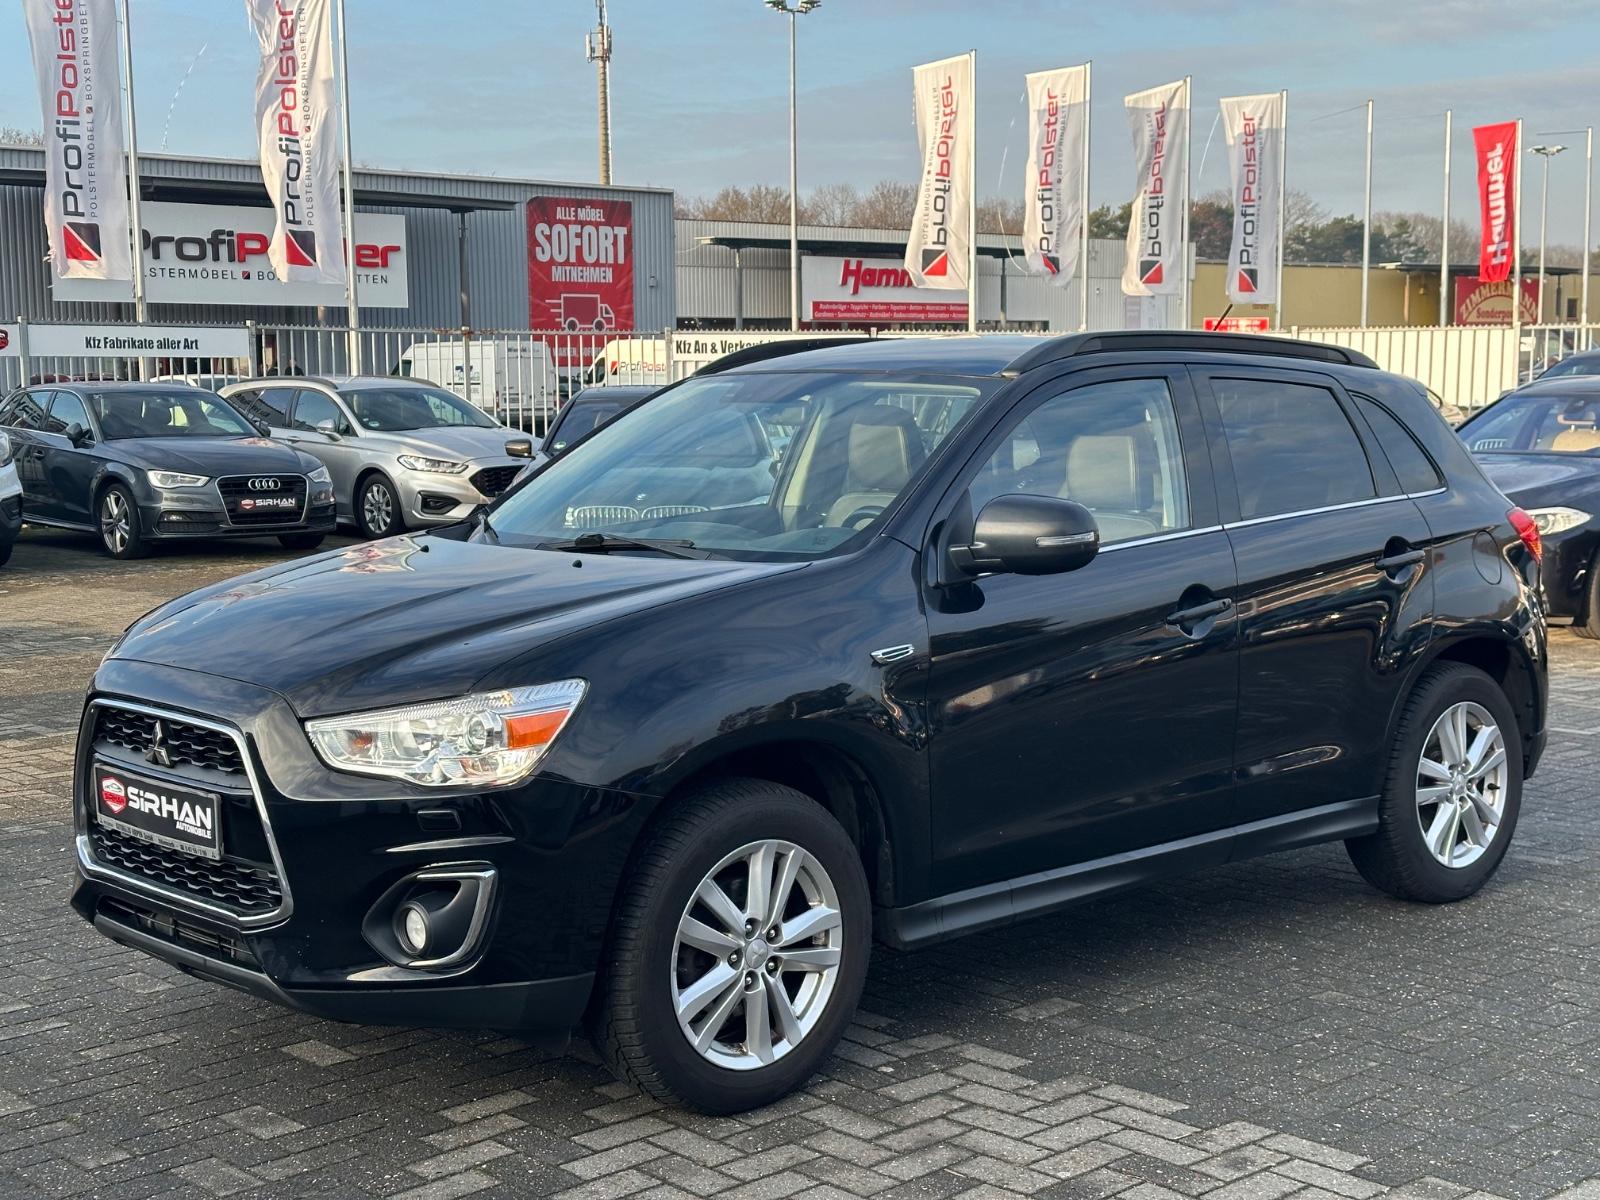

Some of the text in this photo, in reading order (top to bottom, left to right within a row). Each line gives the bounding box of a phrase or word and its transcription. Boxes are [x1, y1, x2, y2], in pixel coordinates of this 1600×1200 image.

[274, 0, 302, 225] ProfiPolster
[1037, 87, 1058, 253] ProfiPolster
[1239, 111, 1256, 265] ProfiPolster
[556, 205, 605, 222] ALLE MÖBEL
[1486, 142, 1509, 265] Hammer
[534, 222, 628, 265] SOFORT
[551, 265, 613, 284] MITNEHMEN
[1459, 281, 1537, 321] ZIMMERMNN
[85, 336, 199, 350] Kfz Fabrikate aller Art
[676, 340, 692, 354] Kfz
[694, 340, 708, 354] An
[710, 341, 718, 354] &
[720, 340, 763, 354] Verk
[175, 820, 212, 840] AUTOMOBILE
